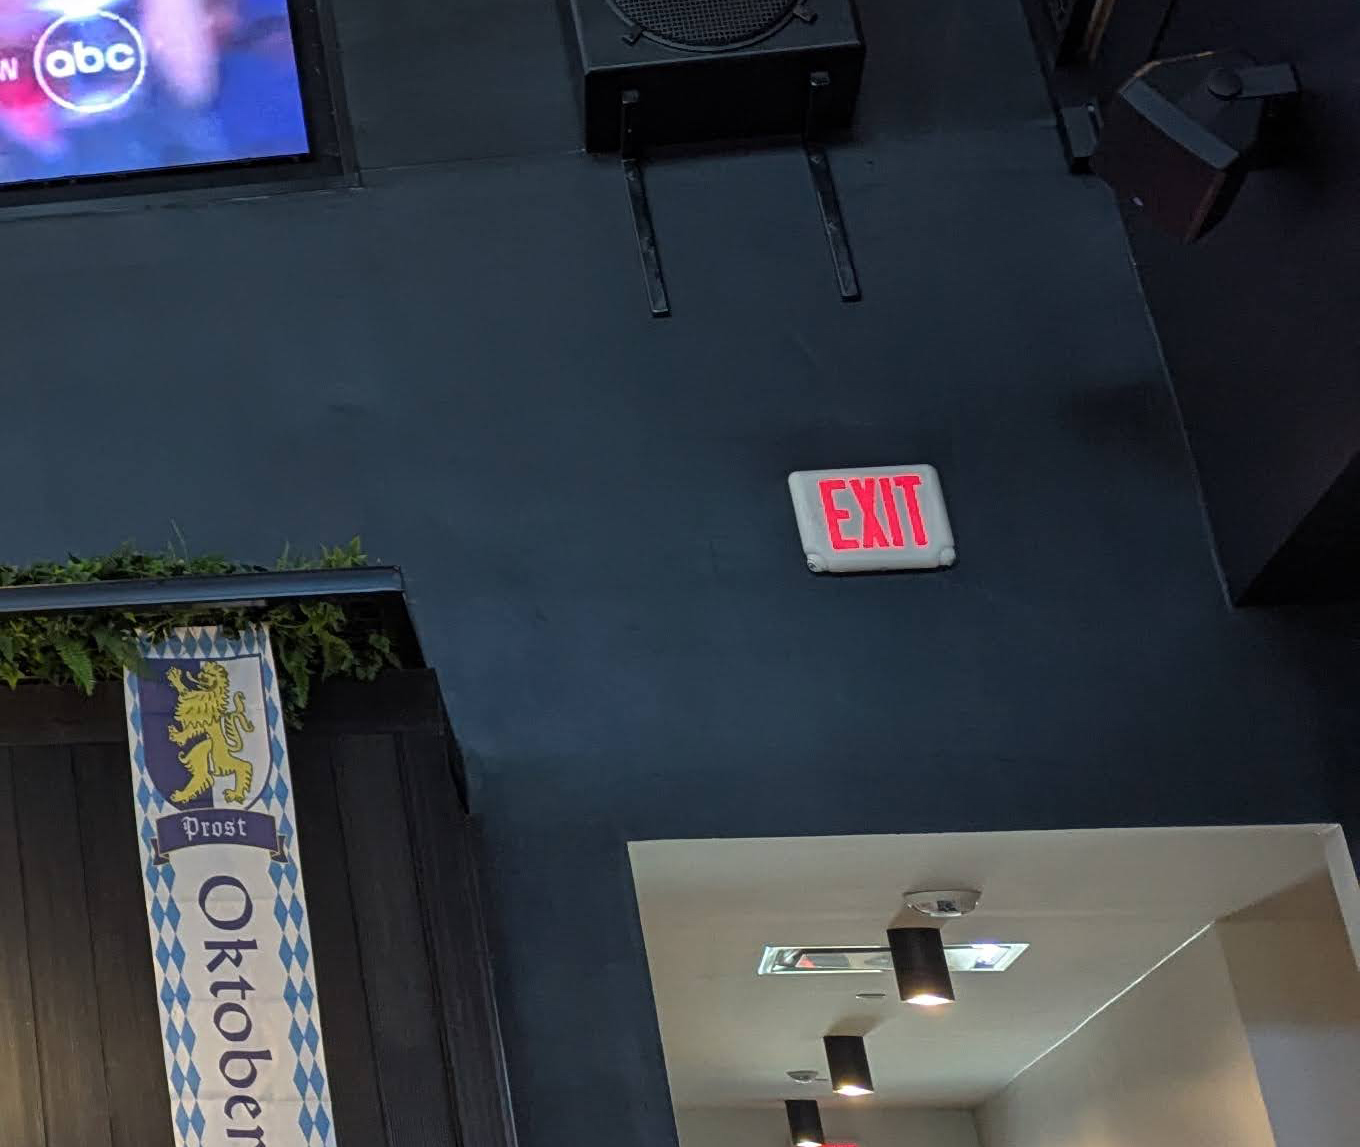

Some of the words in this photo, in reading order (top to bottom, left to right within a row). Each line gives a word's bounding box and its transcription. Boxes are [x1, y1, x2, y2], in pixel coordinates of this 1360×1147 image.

[45, 41, 136, 79] abc
[818, 474, 929, 550] EXIT
[181, 816, 248, 842] Prost
[198, 874, 273, 1147] Oktober
